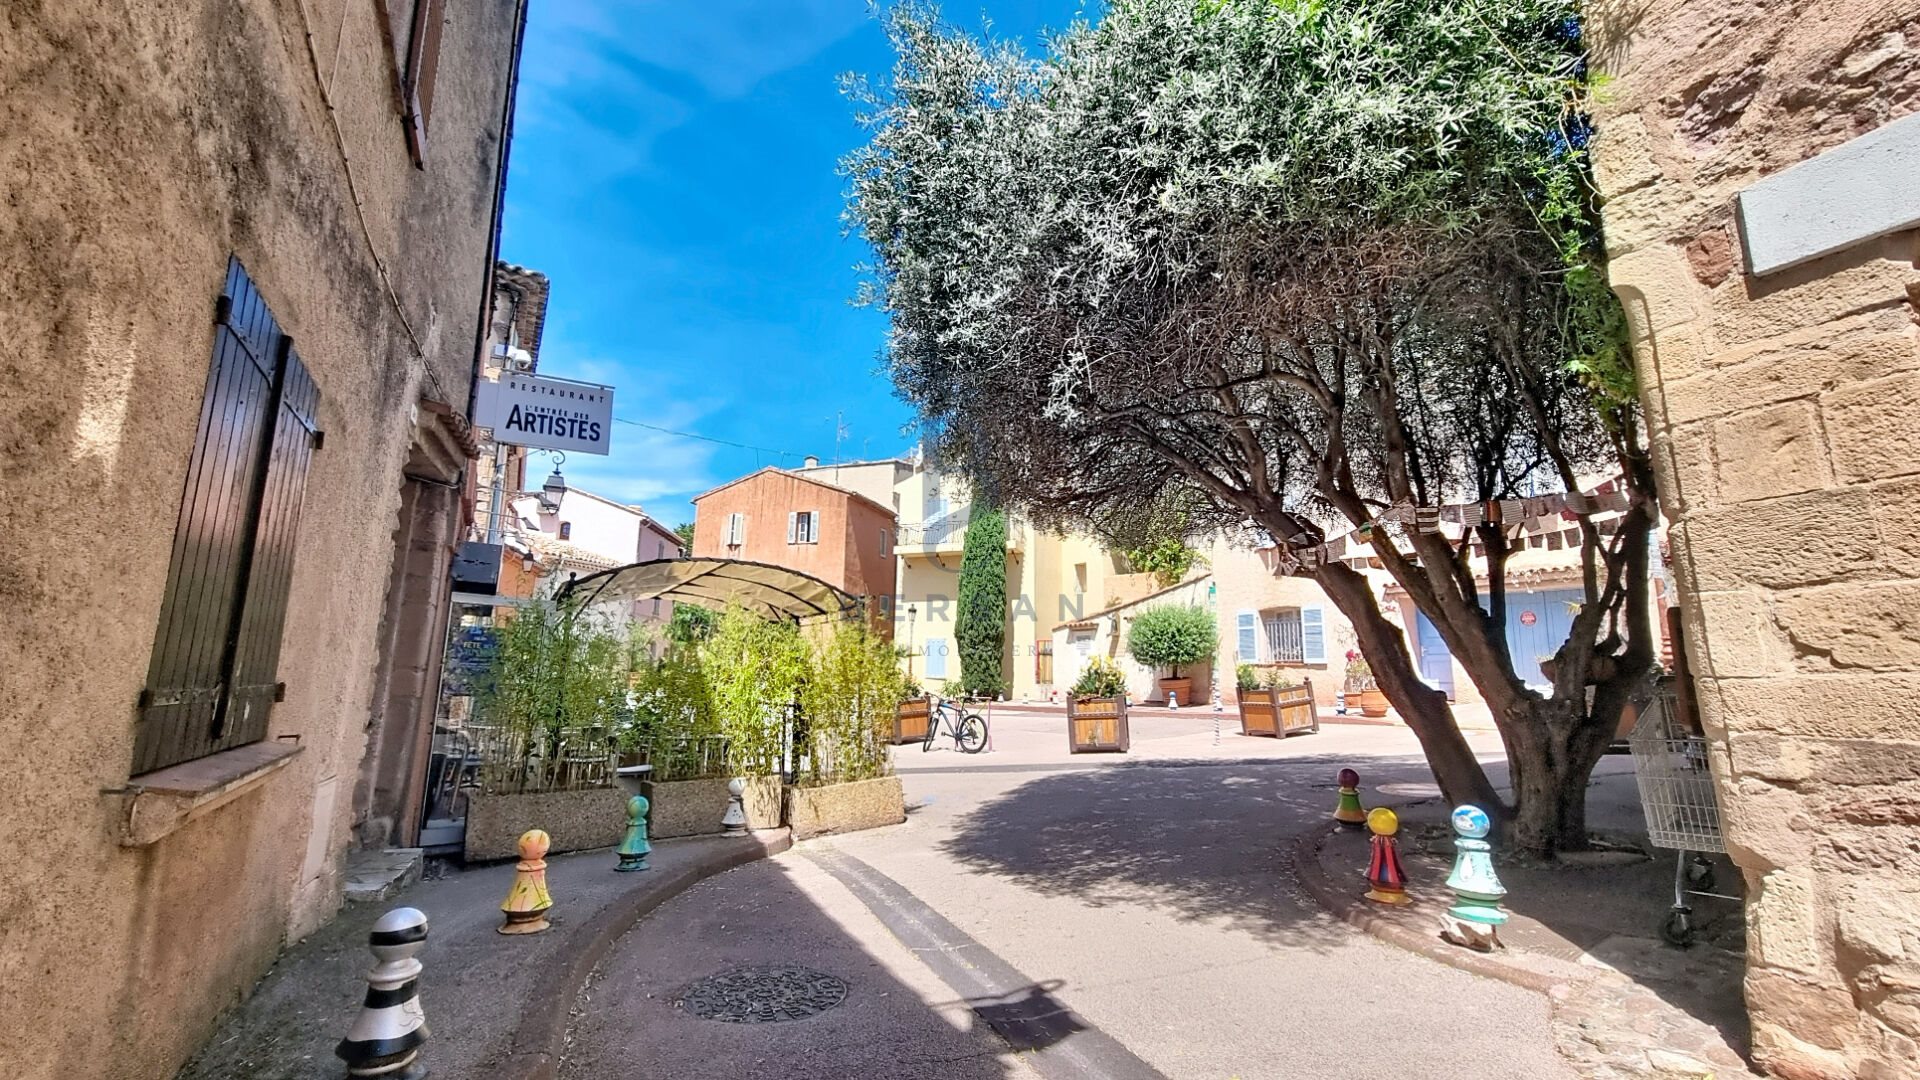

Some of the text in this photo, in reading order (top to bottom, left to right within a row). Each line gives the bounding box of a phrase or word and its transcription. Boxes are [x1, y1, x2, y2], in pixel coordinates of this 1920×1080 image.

[510, 382, 604, 403] RESTAURANT
[505, 404, 601, 442] ARTISTES
[574, 412, 589, 420] DES
